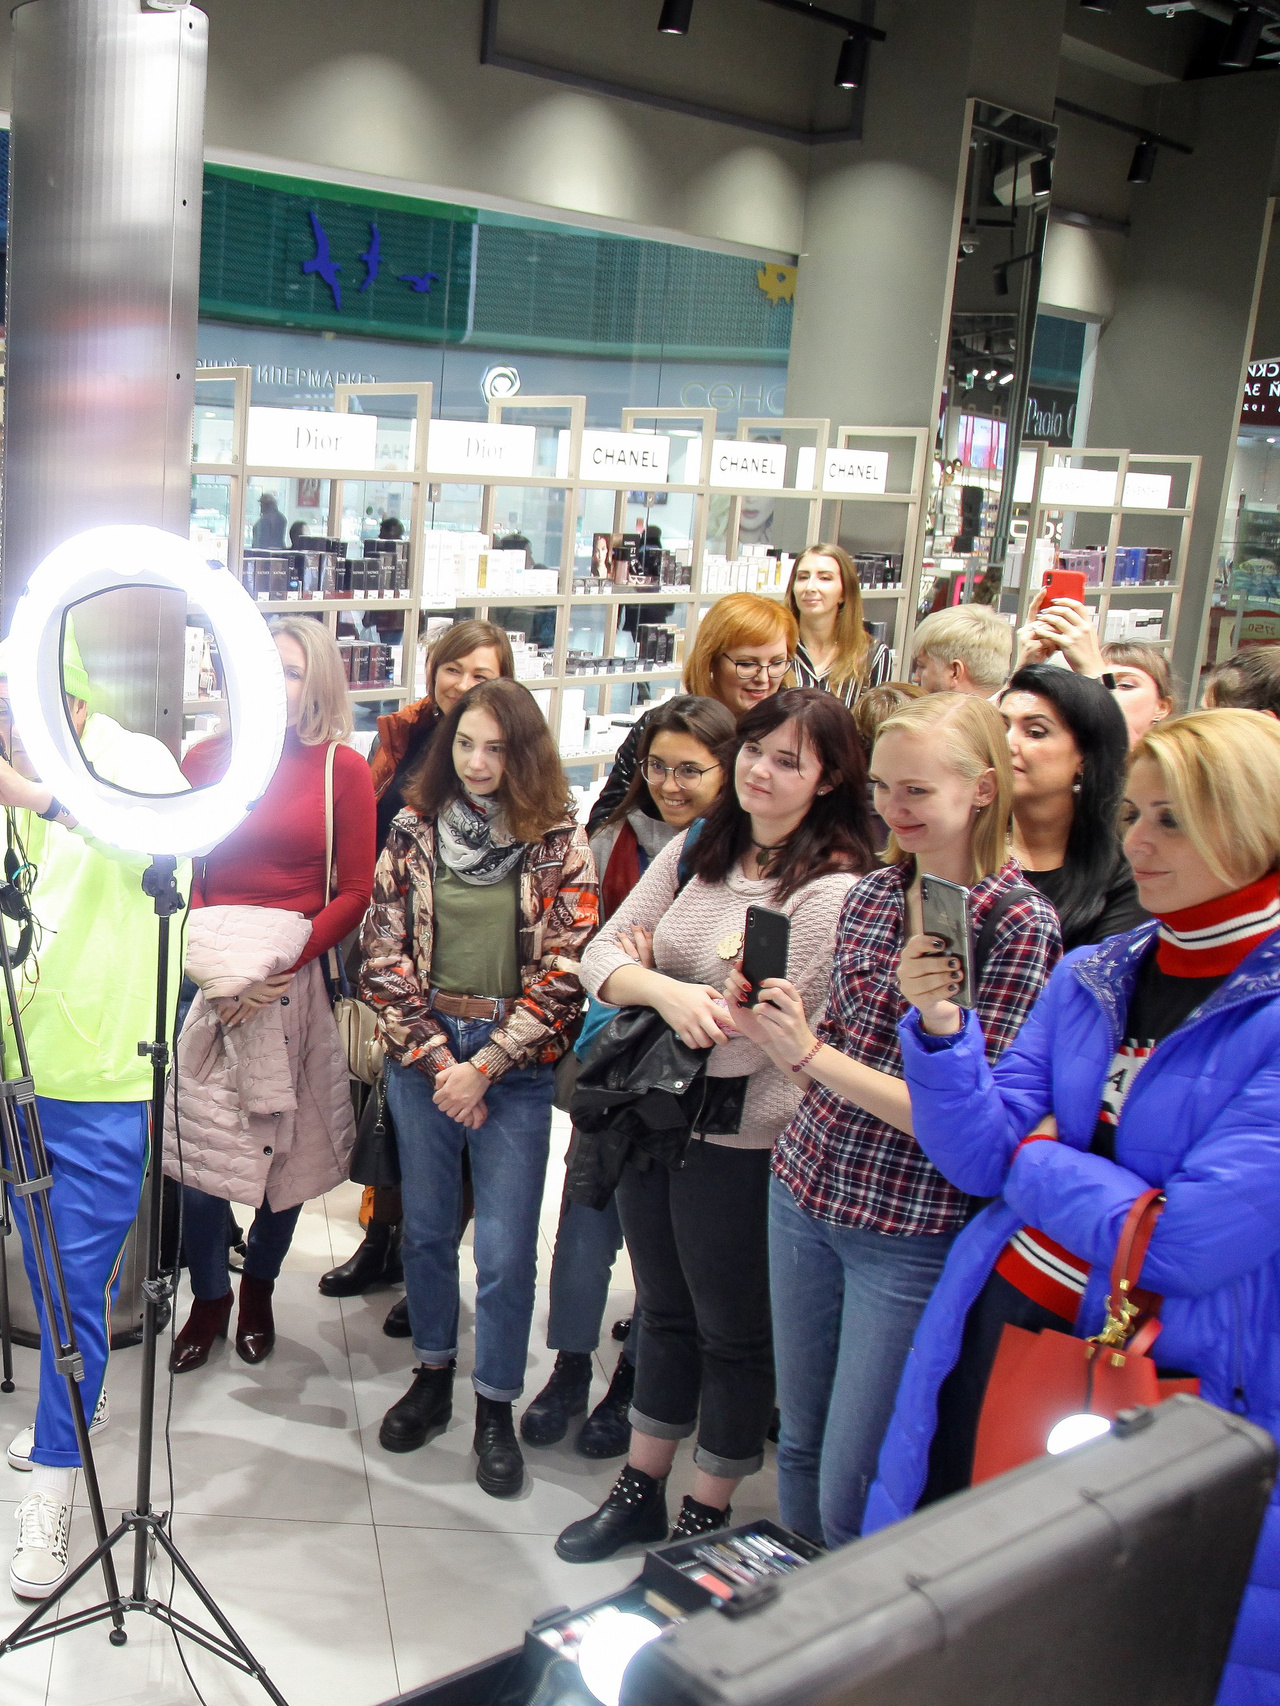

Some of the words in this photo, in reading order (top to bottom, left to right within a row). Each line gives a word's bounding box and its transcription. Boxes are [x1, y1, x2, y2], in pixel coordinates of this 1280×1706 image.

[247, 364, 380, 388] ИПЕРМАРКЕТ
[1024, 397, 1063, 438] Paolo
[295, 426, 342, 451] Dior
[466, 436, 505, 460] Dior
[592, 447, 659, 468] CHANEL
[719, 455, 776, 475] CHANEL
[828, 462, 879, 481] CHANEL
